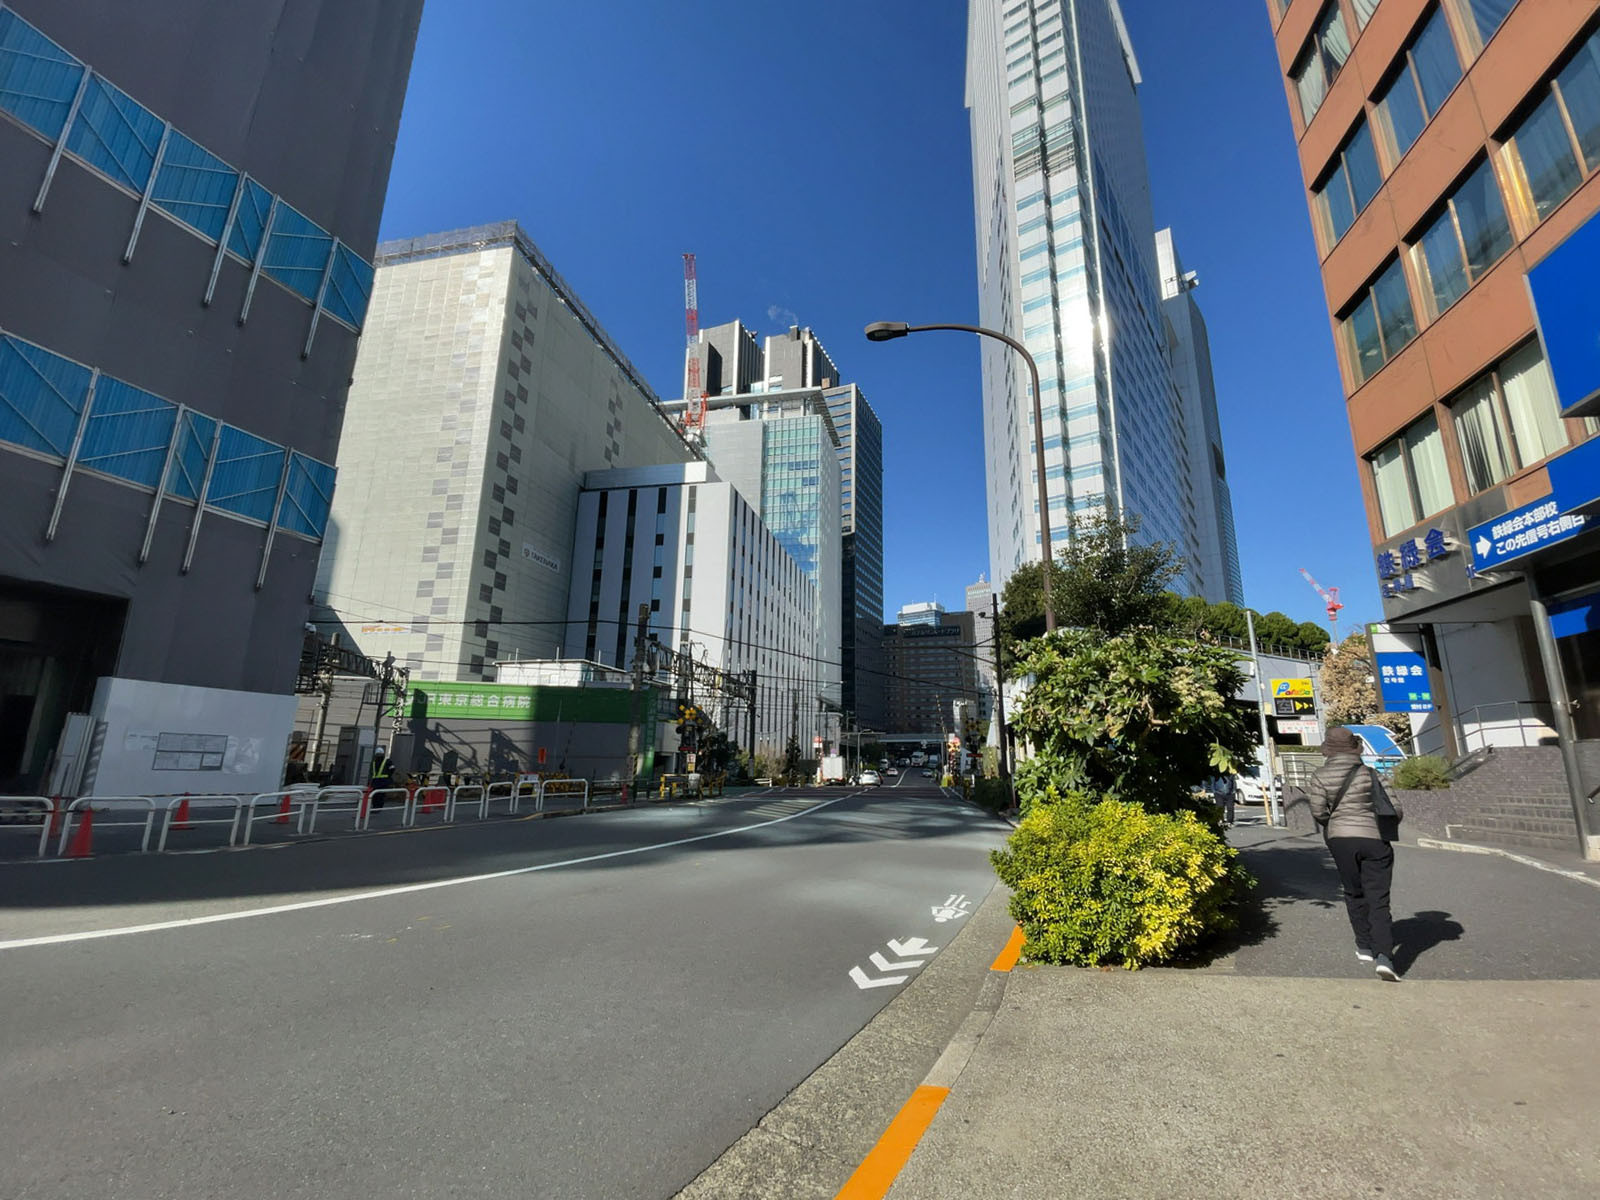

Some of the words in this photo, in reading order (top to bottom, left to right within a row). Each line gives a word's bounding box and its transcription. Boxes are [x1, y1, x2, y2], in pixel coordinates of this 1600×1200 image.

[1492, 501, 1558, 539] 鉄緑会本部校
[1377, 528, 1447, 579] 鉄緑会
